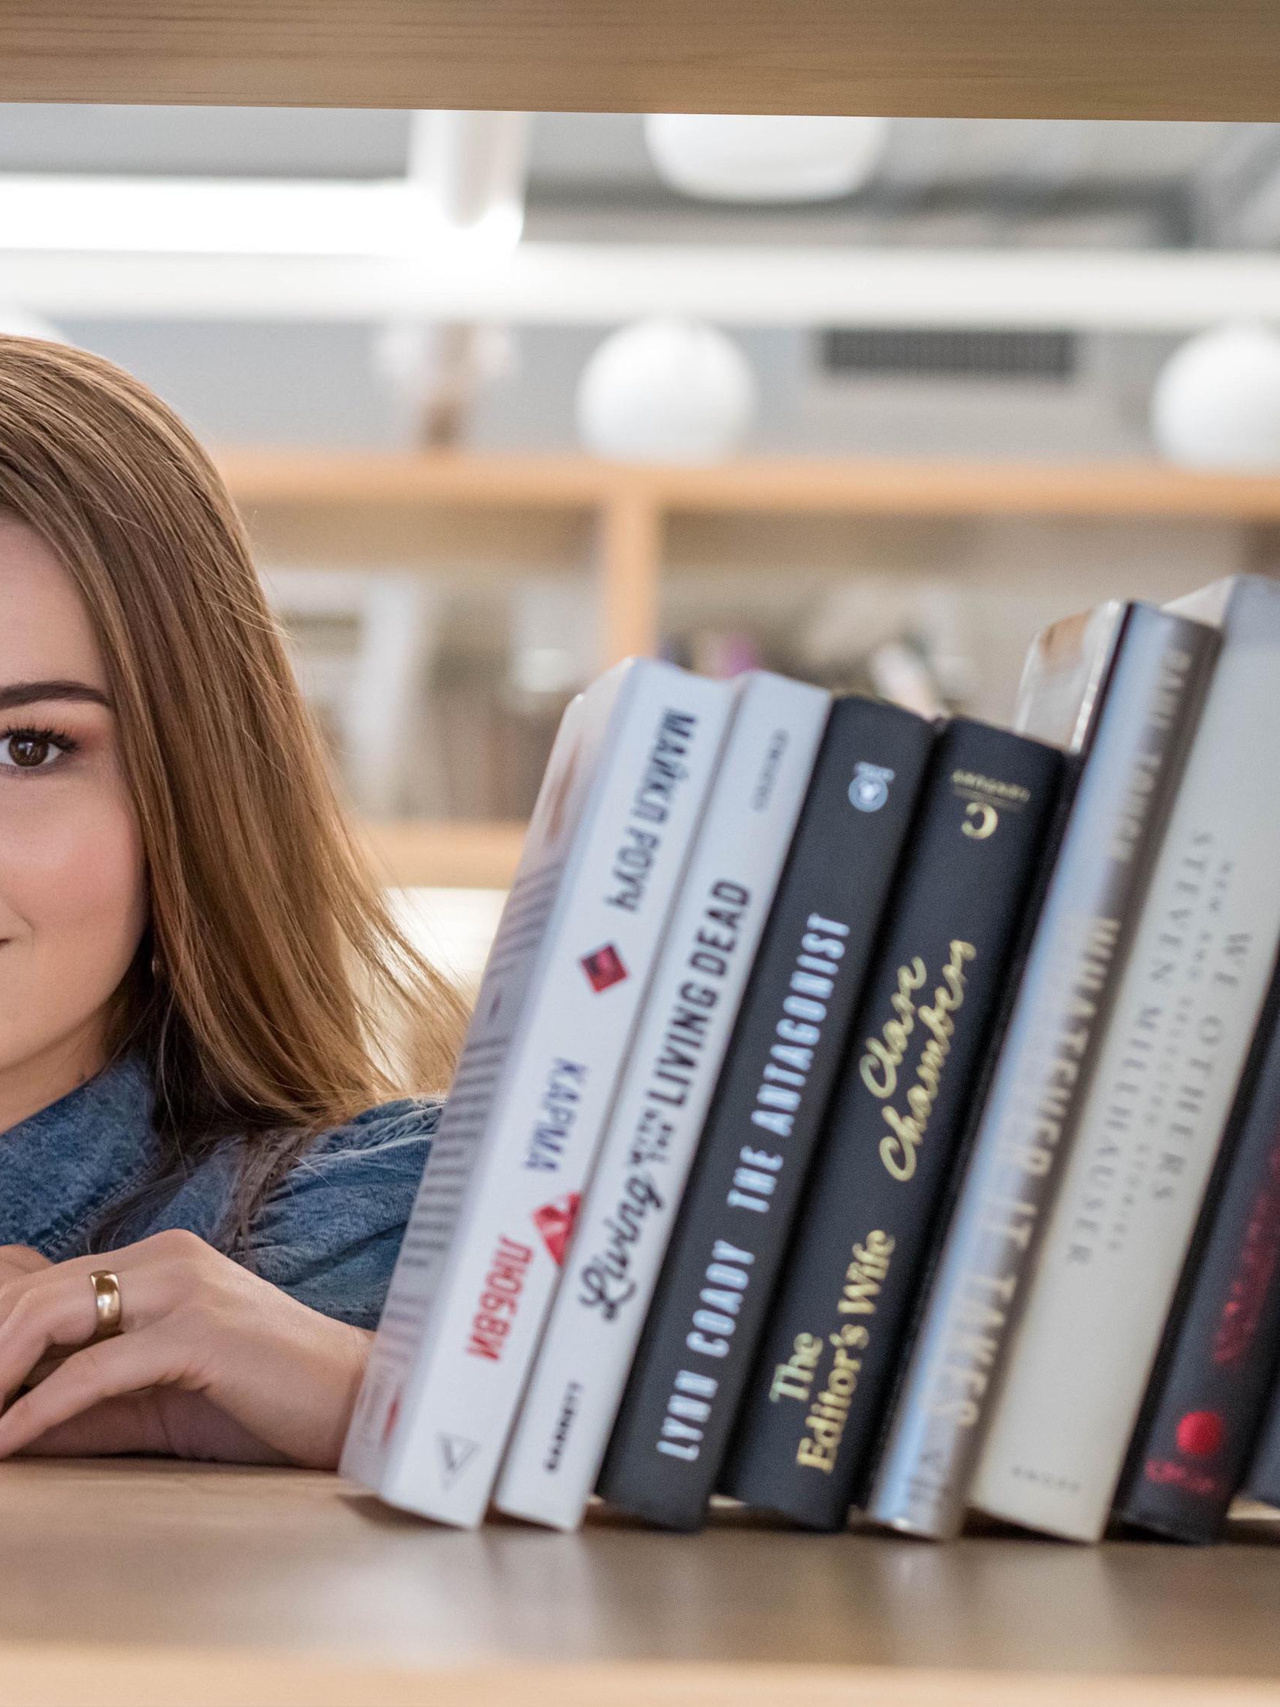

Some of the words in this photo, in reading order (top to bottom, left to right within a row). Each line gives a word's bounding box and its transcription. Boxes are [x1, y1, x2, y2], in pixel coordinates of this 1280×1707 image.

[627, 705, 699, 826] МАЙКЛ
[605, 828, 661, 914] РОУЧ
[1145, 829, 1217, 987] STEVEN
[751, 913, 851, 1137] ANTAGONIST
[860, 956, 927, 1099] Clare
[1212, 928, 1256, 992] WE
[578, 1172, 666, 1323] Living
[646, 979, 720, 1107] LIVING
[689, 878, 751, 978] DEAD
[879, 938, 977, 1182] Chambers
[1006, 914, 1121, 1176] WHATEVER
[1144, 1013, 1229, 1203] OTHERS
[524, 1057, 588, 1174] КАРМА
[727, 1145, 784, 1214] THE
[1060, 1003, 1167, 1267] MILLHAUSER
[981, 1196, 1037, 1251] IT
[465, 1234, 534, 1363] ЛЮБВИ
[687, 1239, 755, 1359] COADY
[796, 1323, 870, 1475] Editor's
[838, 1228, 896, 1316] Wife
[930, 1268, 1018, 1428] TAKES
[656, 1368, 719, 1463] LYNN
[769, 1331, 823, 1403] The
